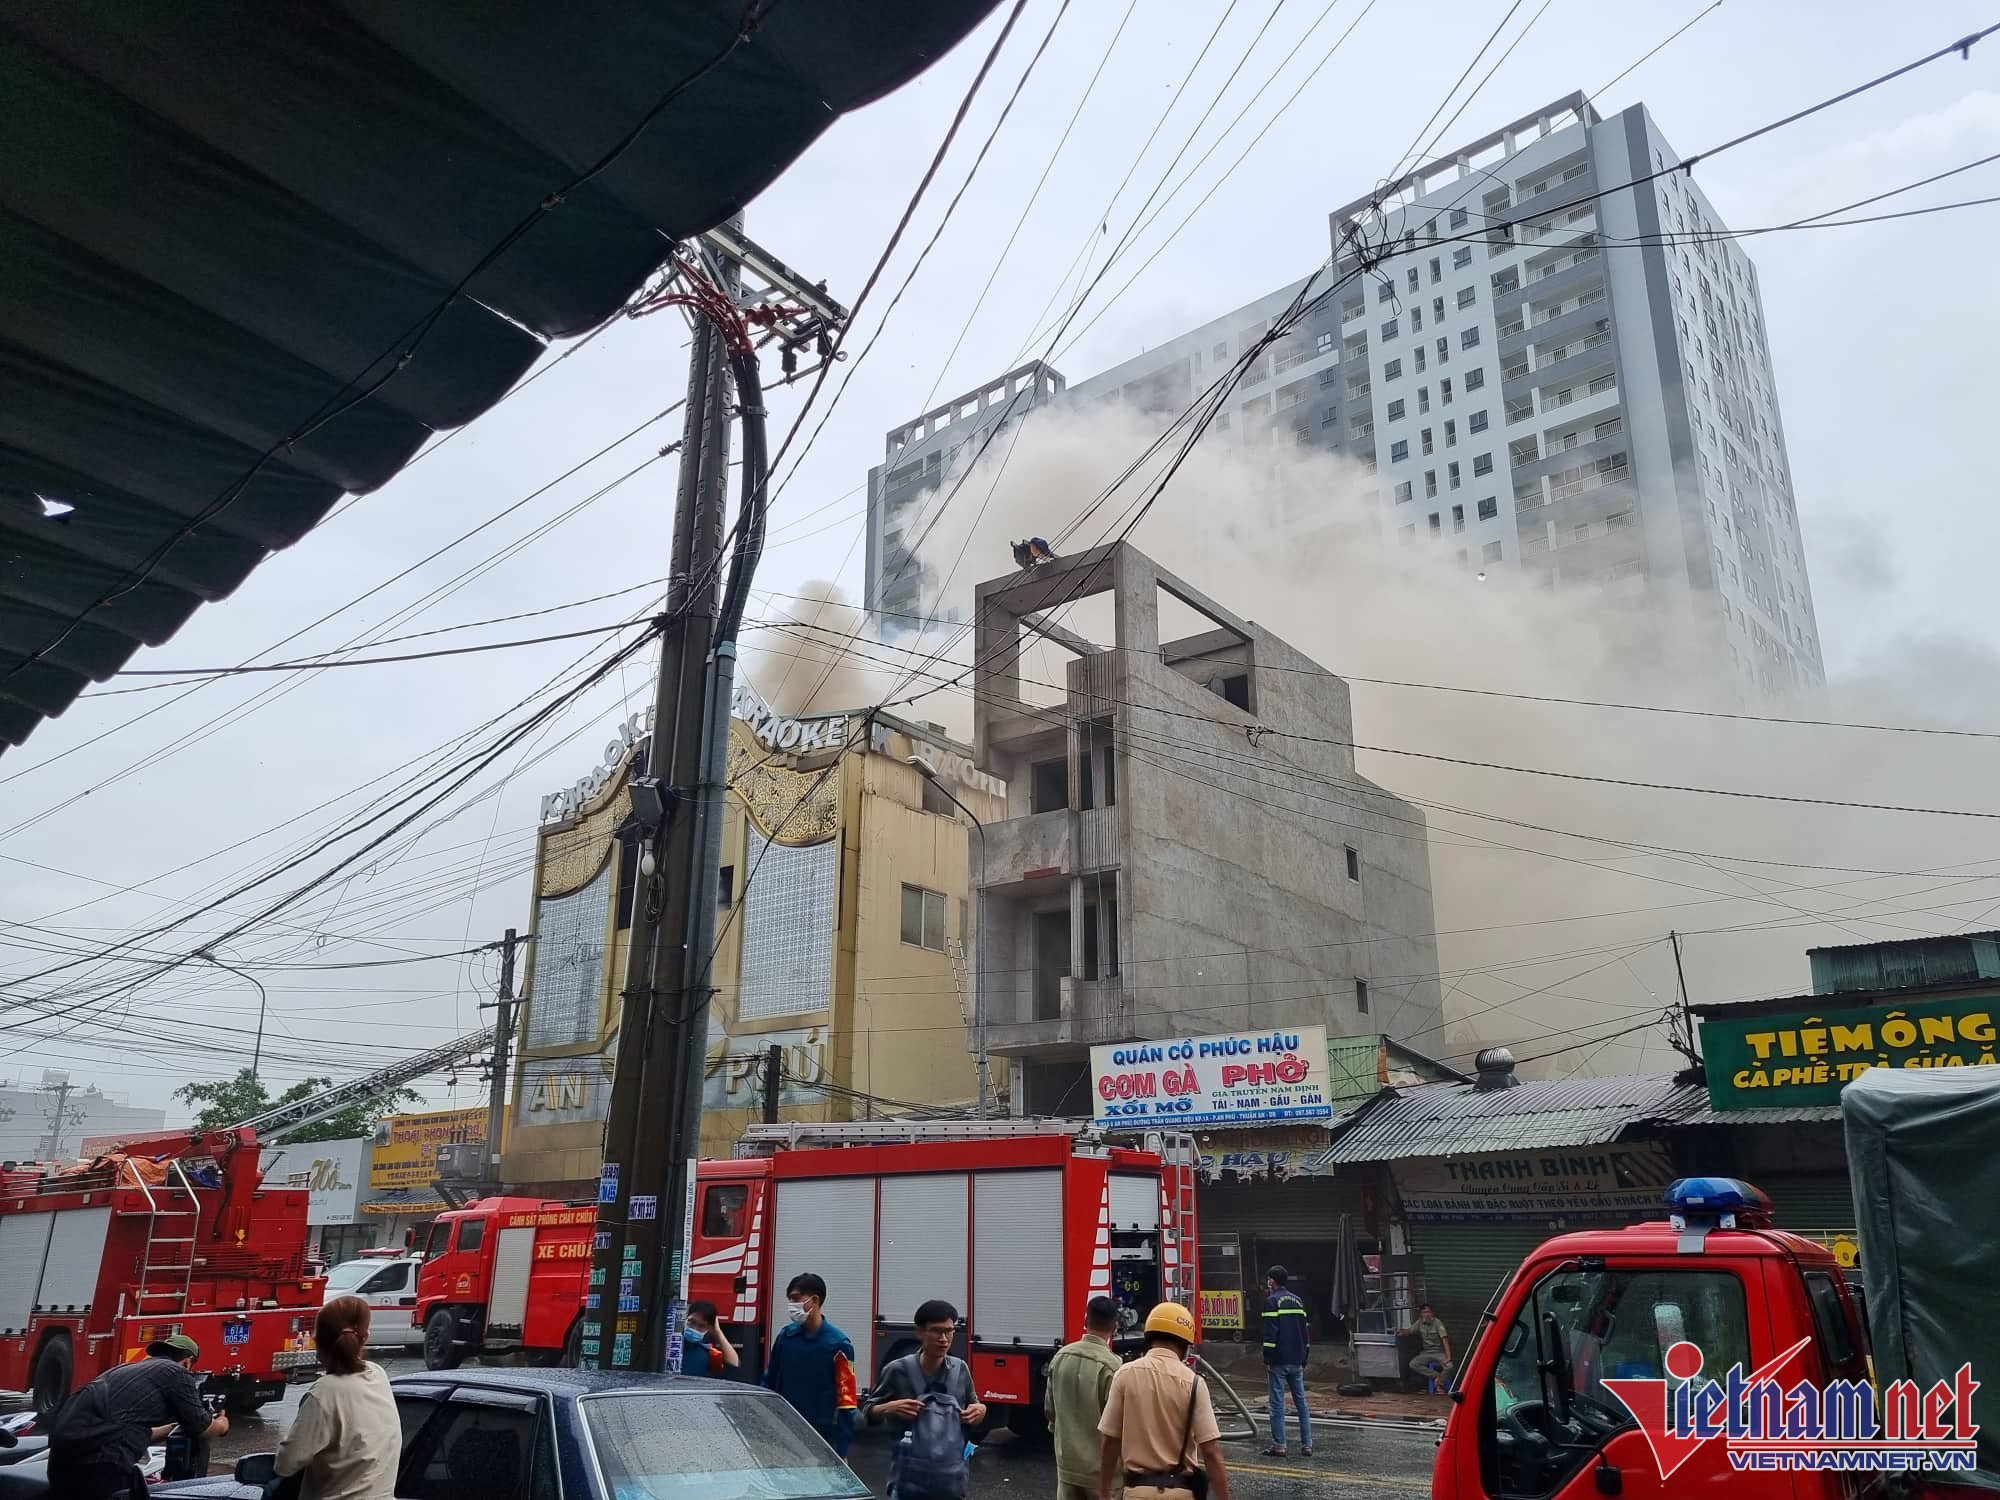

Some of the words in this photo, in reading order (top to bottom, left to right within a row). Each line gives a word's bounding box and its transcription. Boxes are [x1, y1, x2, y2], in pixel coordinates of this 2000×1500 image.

[732, 686, 848, 753] ARAOKE
[1112, 1044, 1163, 1065] QUÁN
[1200, 1037, 1251, 1058] PHÚC
[1257, 1032, 1299, 1056] HẬU
[1745, 1016, 1874, 1062] TIỆM
[1880, 1010, 1997, 1048] ÔNG
[1098, 1071, 1156, 1100] CƠM
[1162, 1062, 1201, 1097] GÀ
[1221, 1053, 1310, 1088] PHỞ
[1733, 1061, 1769, 1089] CÀ
[529, 1070, 587, 1112] AN
[1212, 1089, 1229, 1098] GIA
[1271, 1086, 1291, 1094] NAM
[1104, 1099, 1147, 1117] XỐI
[1155, 1097, 1195, 1114] MỠ
[1444, 1157, 1533, 1181] THANH
[1540, 1152, 1609, 1178] BÌNH
[525, 1212, 536, 1225] SÁT
[538, 1245, 555, 1258] XE
[230, 1326, 244, 1335] 61A
